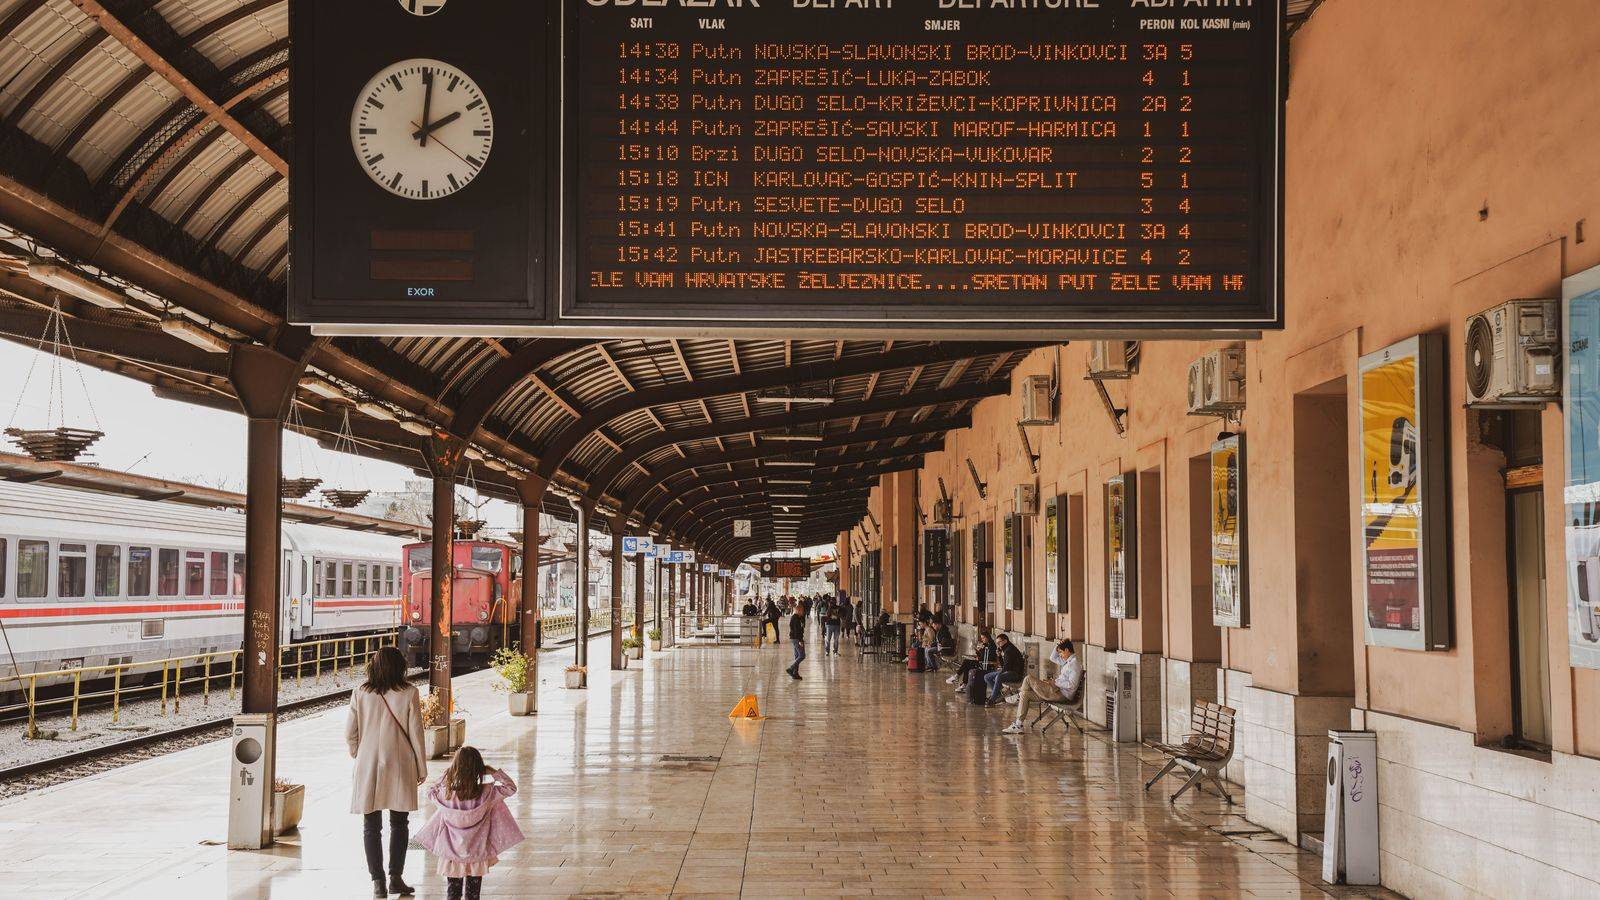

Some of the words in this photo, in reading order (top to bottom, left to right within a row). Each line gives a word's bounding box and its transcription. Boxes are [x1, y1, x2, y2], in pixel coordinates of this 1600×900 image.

[630, 17, 653, 29] SATI
[698, 18, 726, 30] VLAK
[924, 19, 961, 31] SMJER
[1140, 19, 1175, 30] PERON
[1180, 19, 1200, 30] KOL
[1202, 18, 1230, 30] KASNI
[1232, 20, 1251, 31] (min)
[619, 42, 680, 59] 14:30
[692, 43, 742, 60] Putn
[754, 43, 952, 61] NOVSKA-SLAVONSKI
[966, 44, 1127, 61] BROD-VINKOVCI
[1142, 44, 1168, 61] 3A
[1180, 44, 1193, 61] 5
[619, 68, 679, 85] 14:34
[692, 68, 742, 85] Putn
[1142, 69, 1154, 86] 4
[1181, 69, 1191, 87] 1
[619, 93, 679, 110] 14:38
[692, 94, 742, 111] Putn
[754, 94, 804, 112] DUGO
[816, 93, 1117, 112] SELO-KRIŽEVCI-KOPRIVNICA
[1142, 95, 1167, 112] 2A
[1179, 95, 1192, 112] 2
[619, 119, 679, 135] 14:44
[692, 119, 742, 136] Putn
[953, 120, 1116, 138] MAROF-HARMICA
[1142, 121, 1152, 138] 1
[1181, 121, 1191, 138] 1
[619, 144, 679, 161] 15:10
[691, 145, 740, 162] Brzi
[754, 145, 804, 162] DUGO
[816, 146, 1053, 163] SELO-NOVSKA-VUKOVAR
[1141, 146, 1154, 163] 2
[1179, 146, 1192, 163] 2
[619, 169, 679, 187] 15:18
[693, 170, 729, 187] ICN
[1140, 172, 1153, 189] 5
[1180, 172, 1190, 189] 1
[618, 195, 679, 212] 15:19
[691, 196, 742, 213] Putn
[753, 196, 903, 214] SESVETE-DUGO
[915, 197, 965, 214] SELO
[1141, 197, 1153, 214] 3
[1178, 197, 1191, 214] 4
[618, 220, 677, 237] 15:41
[690, 221, 741, 238] Putn
[753, 221, 950, 239] NOVSKA-SLAVONSKI
[964, 223, 1126, 240] BROD-VINKOVCI
[1140, 223, 1167, 240] 3A
[1178, 223, 1191, 240] 4
[618, 245, 678, 263] 15:42
[690, 246, 741, 263] Putn
[753, 247, 1128, 265] JASTREBARSKO-KARLOVAC-MORAVICE
[1140, 249, 1153, 265] 4
[1178, 248, 1191, 266] 2
[633, 271, 675, 288] VAM
[684, 271, 786, 289] HRVATSKE
[1057, 273, 1098, 291] PUT
[1109, 271, 1161, 291] ŽELE
[1171, 274, 1213, 291] VAM
[407, 287, 435, 296] EXOR
